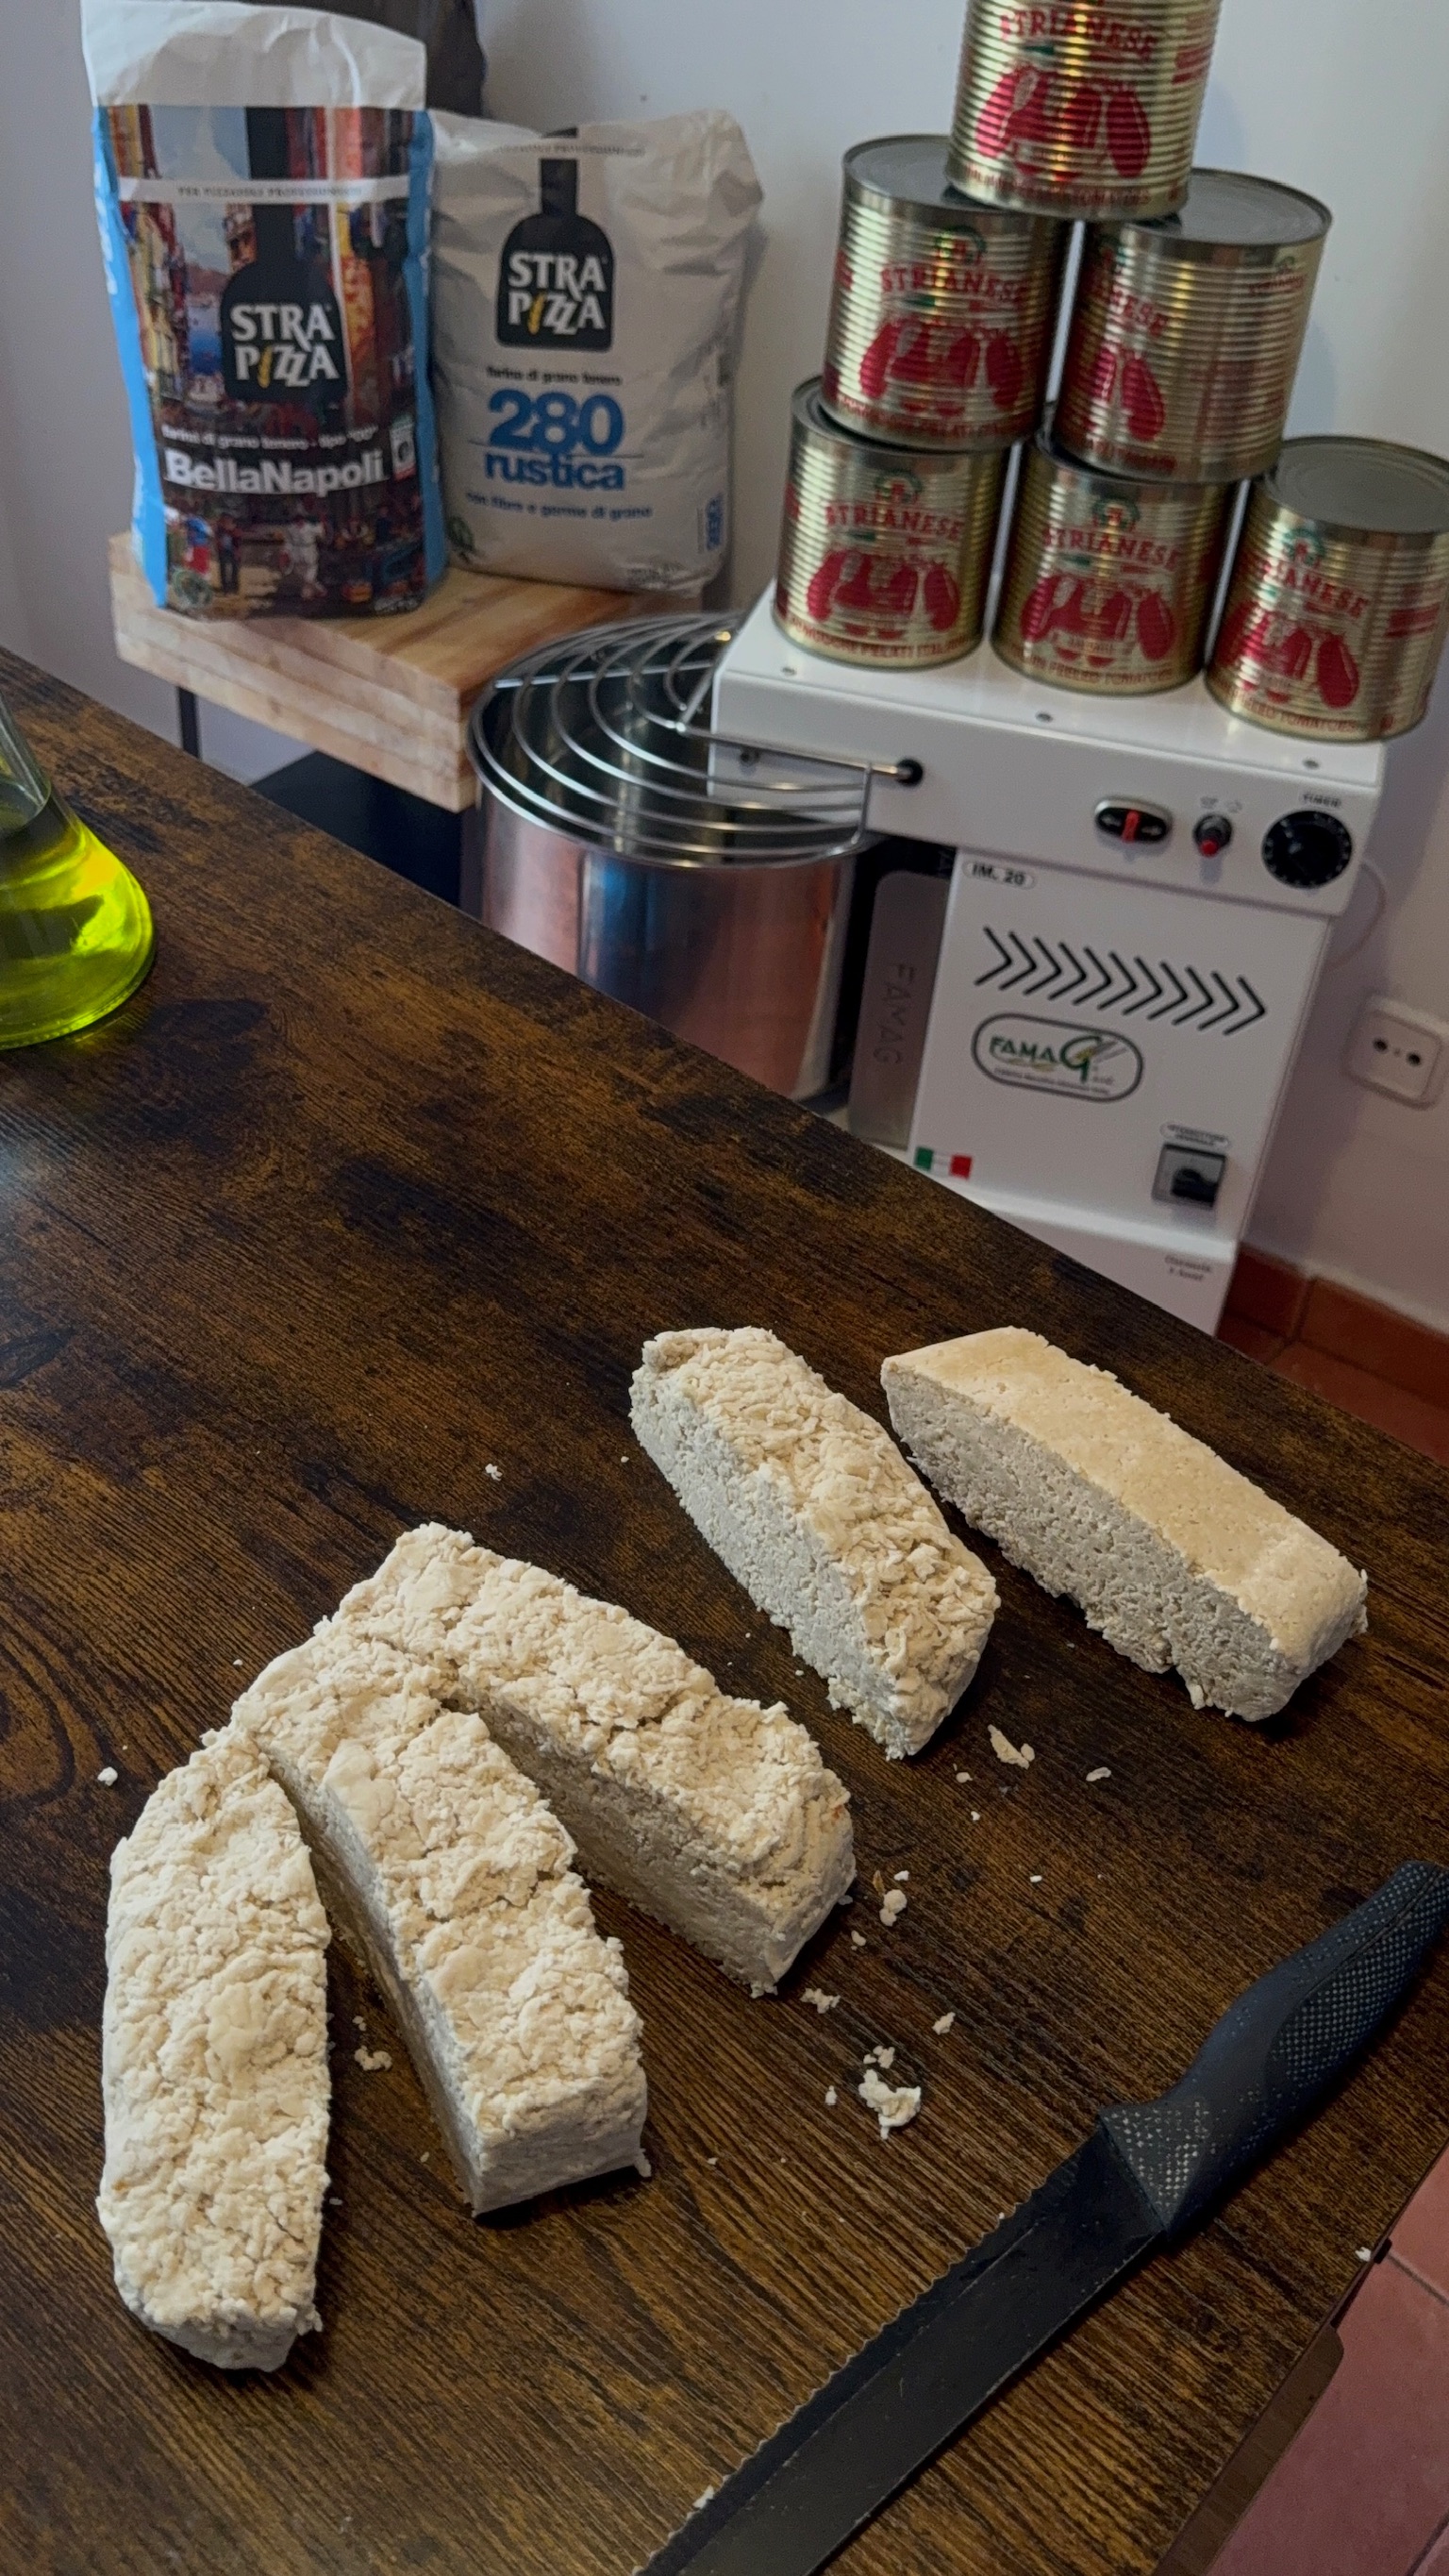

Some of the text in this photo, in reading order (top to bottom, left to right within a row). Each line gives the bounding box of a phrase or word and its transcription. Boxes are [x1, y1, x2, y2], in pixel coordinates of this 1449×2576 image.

[508, 252, 607, 300] STRA
[230, 303, 335, 350] STRA
[508, 289, 606, 335] PIZZA
[235, 343, 340, 388] PIZZA
[487, 388, 625, 457] 280
[164, 446, 384, 497] BellaNapoli
[484, 450, 625, 491] rustica
[824, 501, 966, 542] STRIANESE
[1042, 527, 1181, 573] STRIANESE
[1004, 867, 1025, 886] 20
[874, 962, 916, 1064] FAMAG
[990, 1035, 1103, 1084] FAMAG
